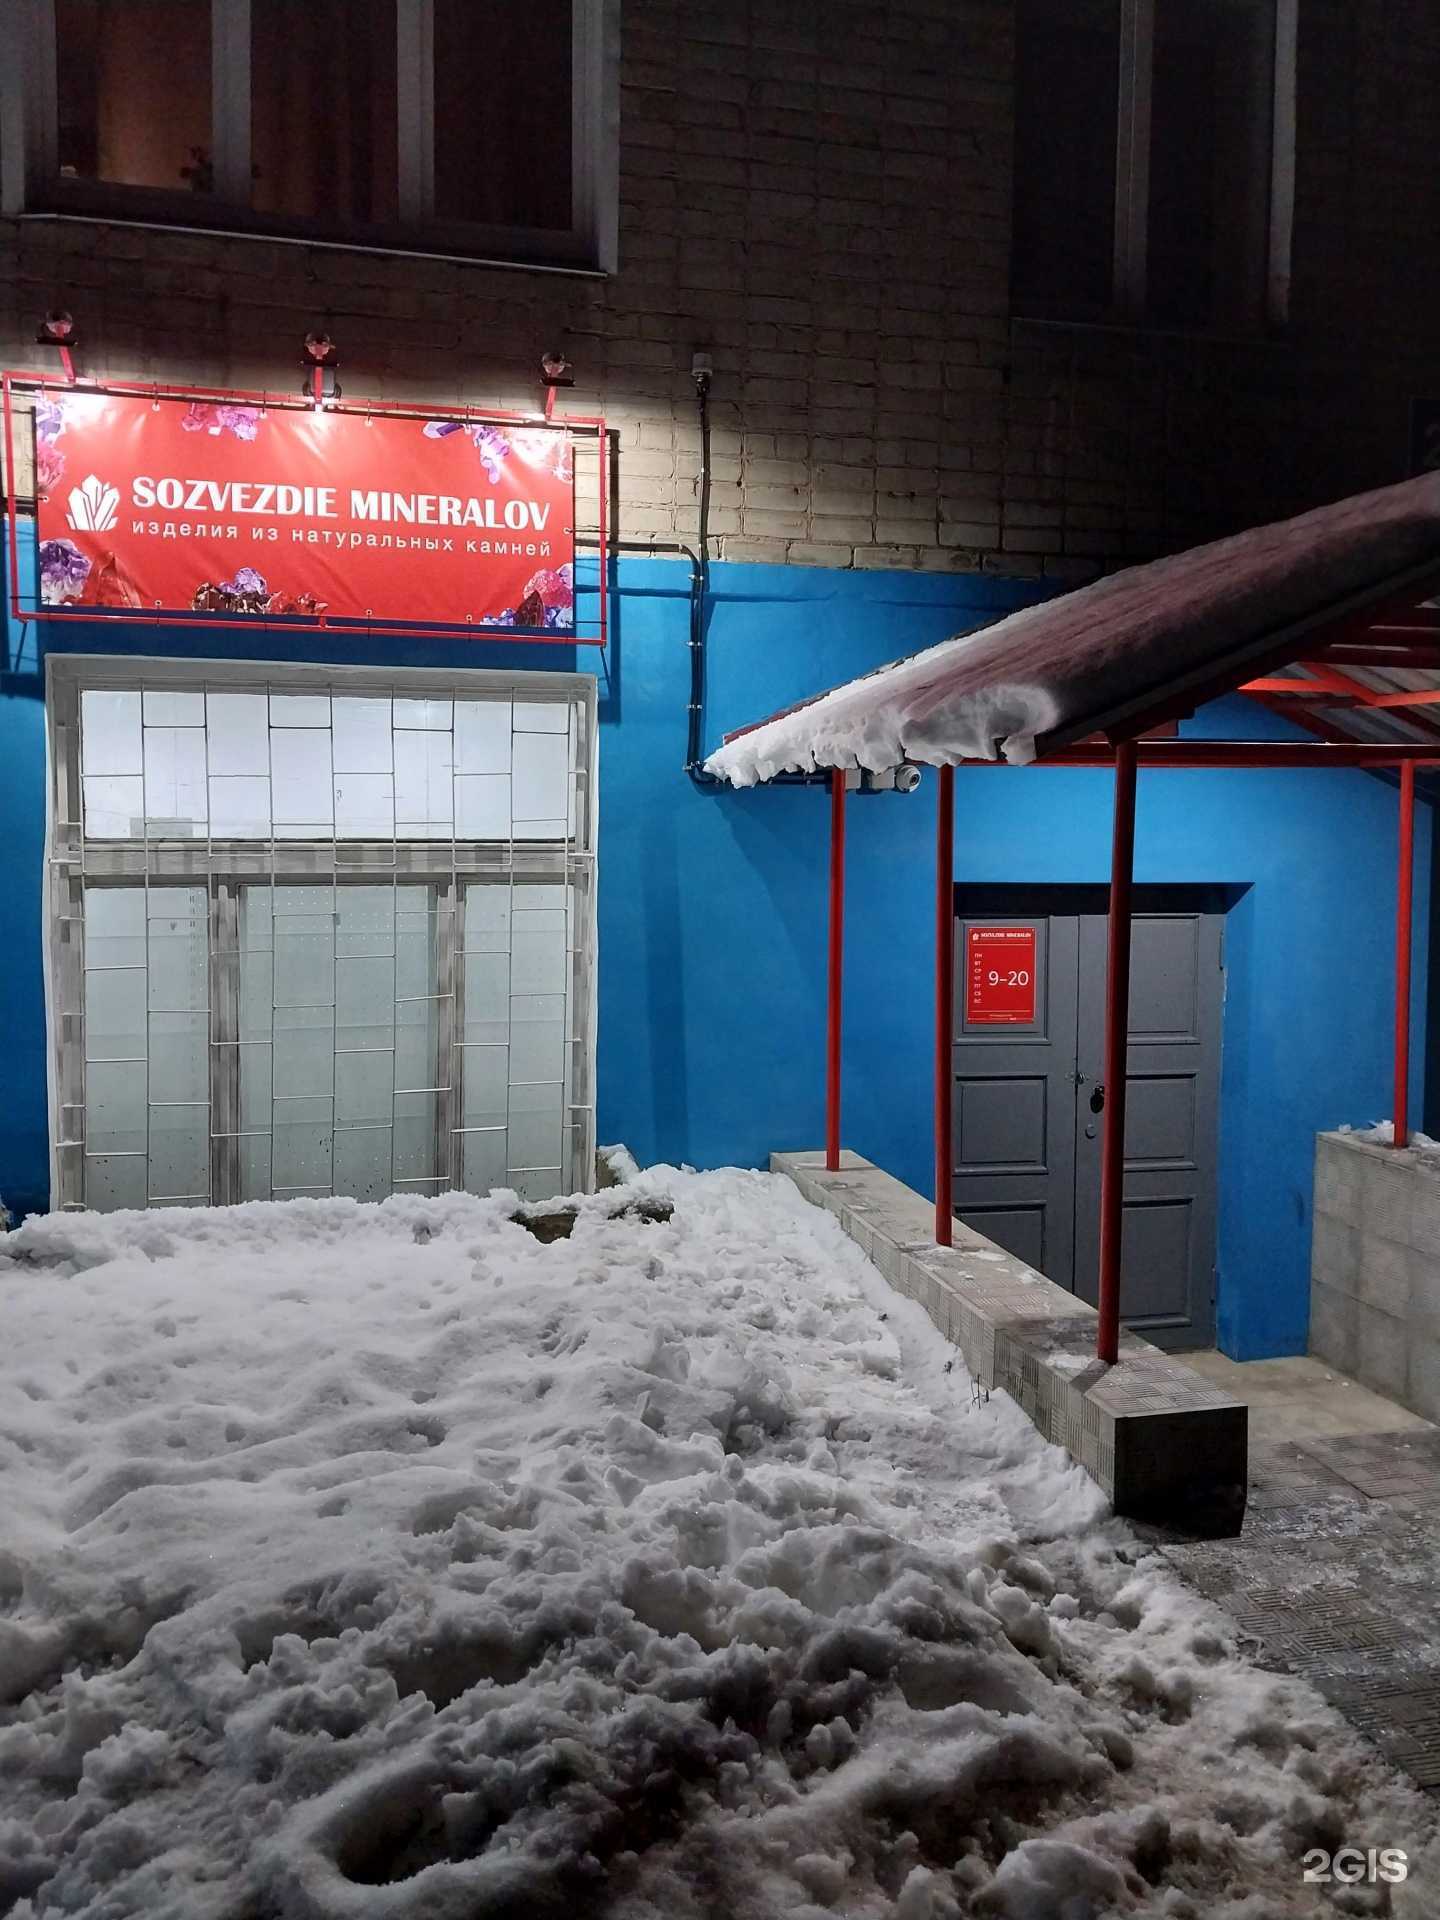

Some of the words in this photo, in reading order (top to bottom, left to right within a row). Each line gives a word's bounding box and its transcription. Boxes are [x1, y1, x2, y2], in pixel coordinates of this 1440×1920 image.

[132, 475, 338, 518] SOZVEZDIE
[350, 488, 552, 532] MINERALOV
[131, 519, 239, 540] изделия
[250, 526, 280, 542] из
[291, 528, 455, 554] натуральных
[465, 539, 552, 557] камней
[988, 970, 1029, 986] 9-20
